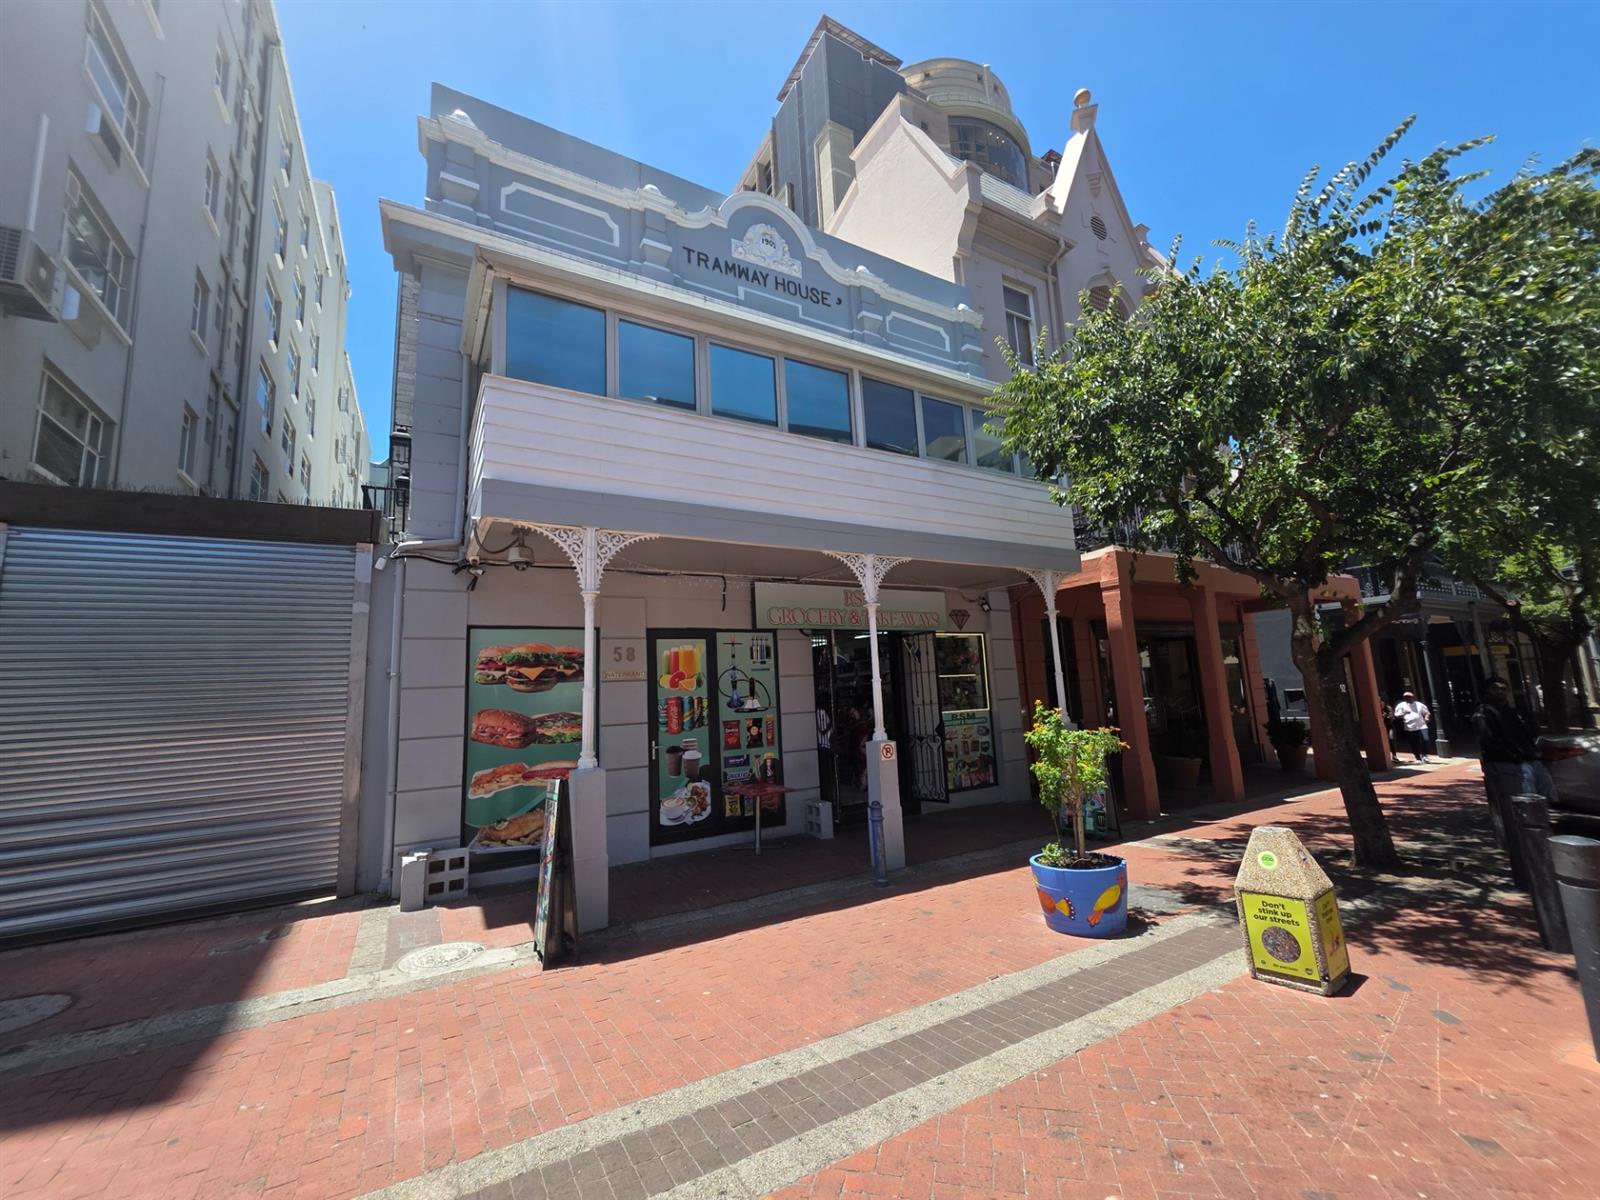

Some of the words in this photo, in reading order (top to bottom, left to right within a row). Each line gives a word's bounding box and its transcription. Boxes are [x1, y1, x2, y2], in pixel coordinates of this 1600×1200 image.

[682, 246, 770, 288] TRAMWAY
[767, 606, 845, 626] GROCERY
[849, 609, 860, 625] &
[613, 646, 636, 663] 58
[1261, 900, 1286, 910] Don't
[1258, 908, 1280, 917] stink
[1280, 911, 1292, 919] up
[1269, 916, 1300, 927] streets
